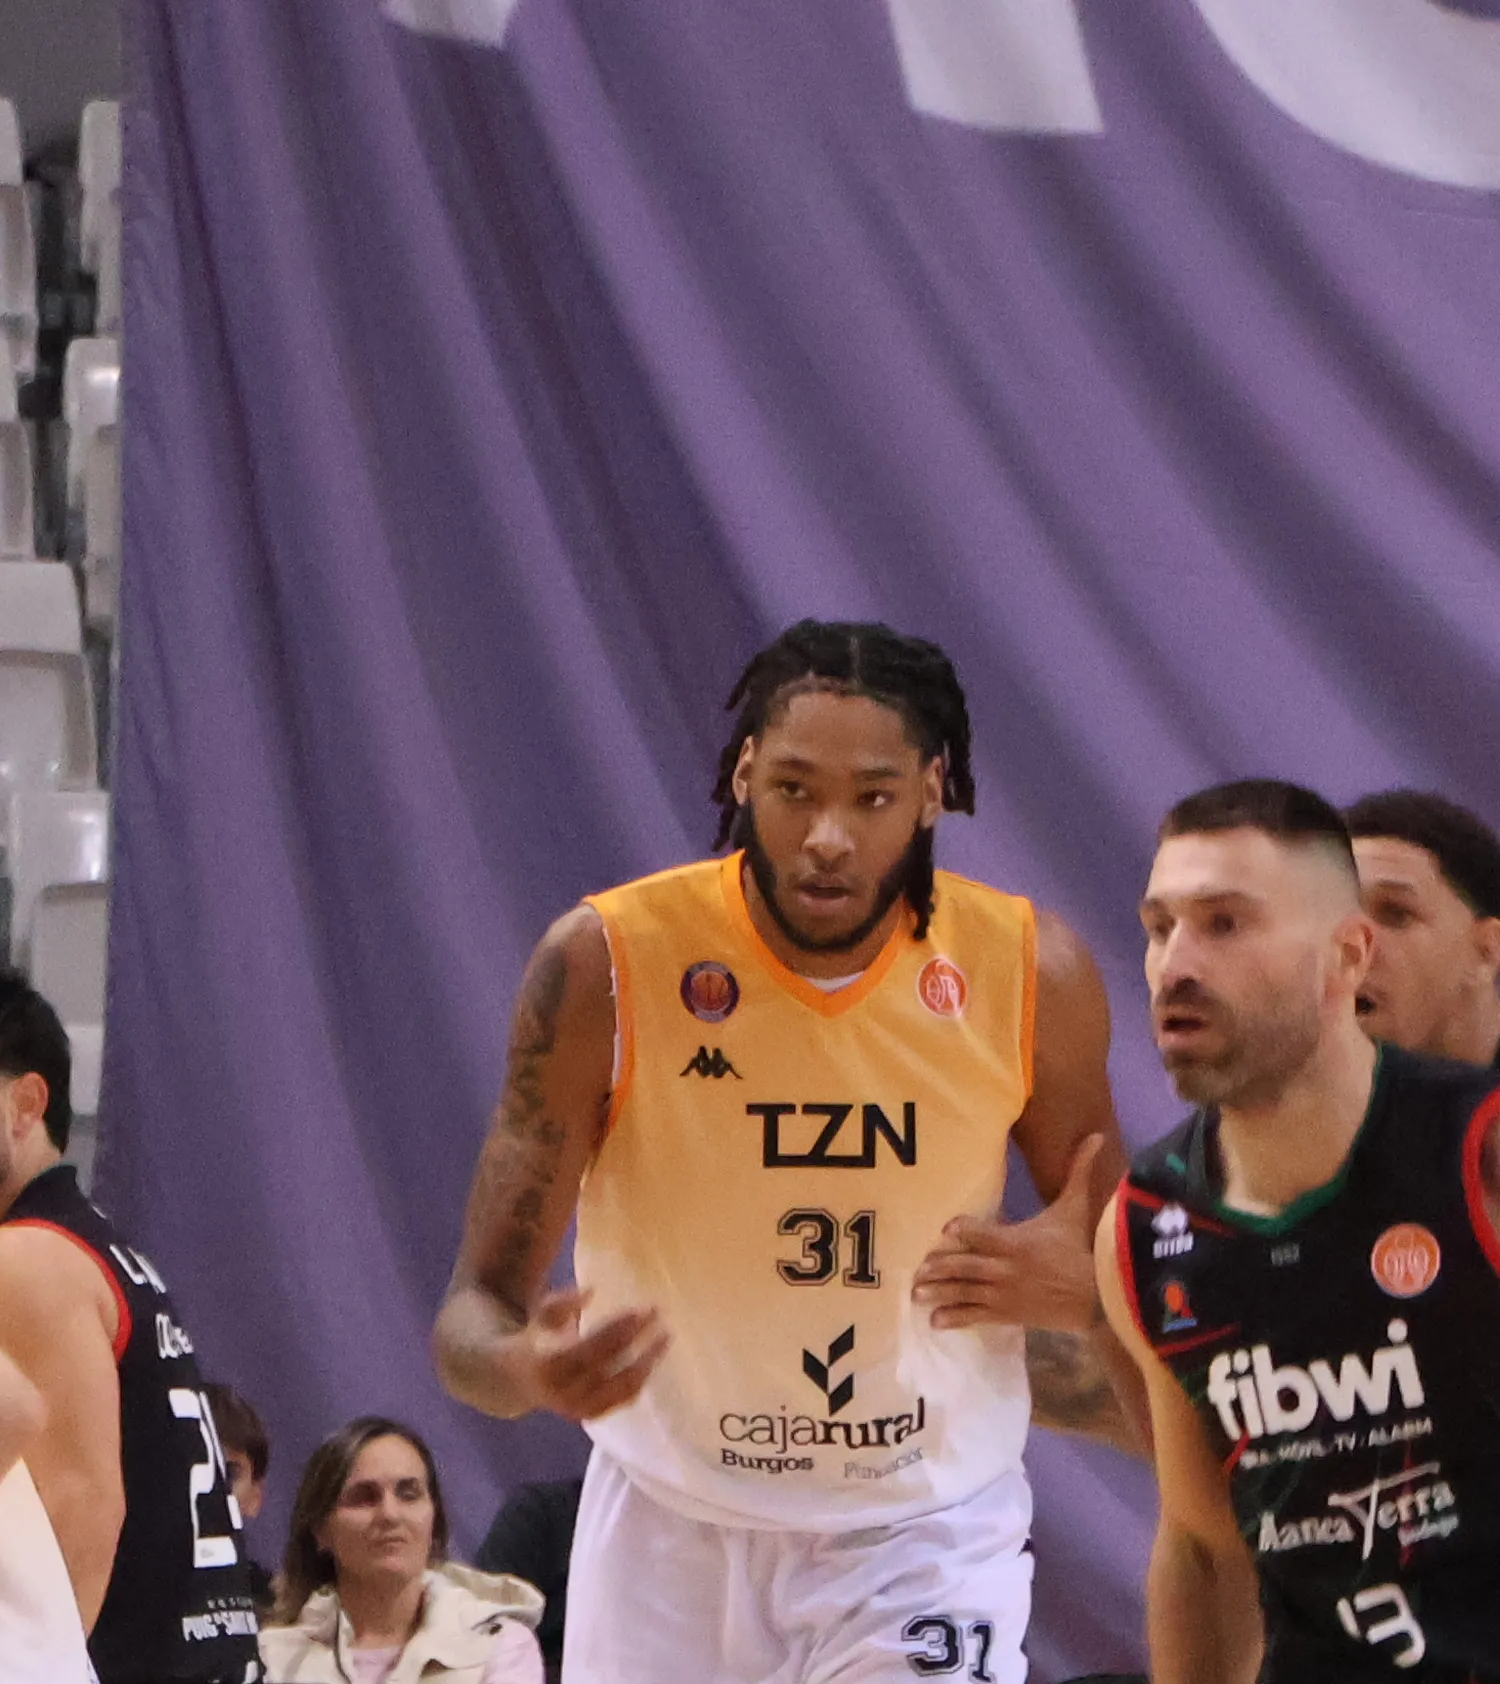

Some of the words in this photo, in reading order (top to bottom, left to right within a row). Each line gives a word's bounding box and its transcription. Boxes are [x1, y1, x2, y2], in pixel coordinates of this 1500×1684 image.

[746, 1102, 917, 1168] TZN
[776, 1208, 880, 1289] 31
[1207, 1318, 1425, 1440] fibwi
[720, 1396, 925, 1454] cajarural
[721, 1448, 814, 1473] Burgos
